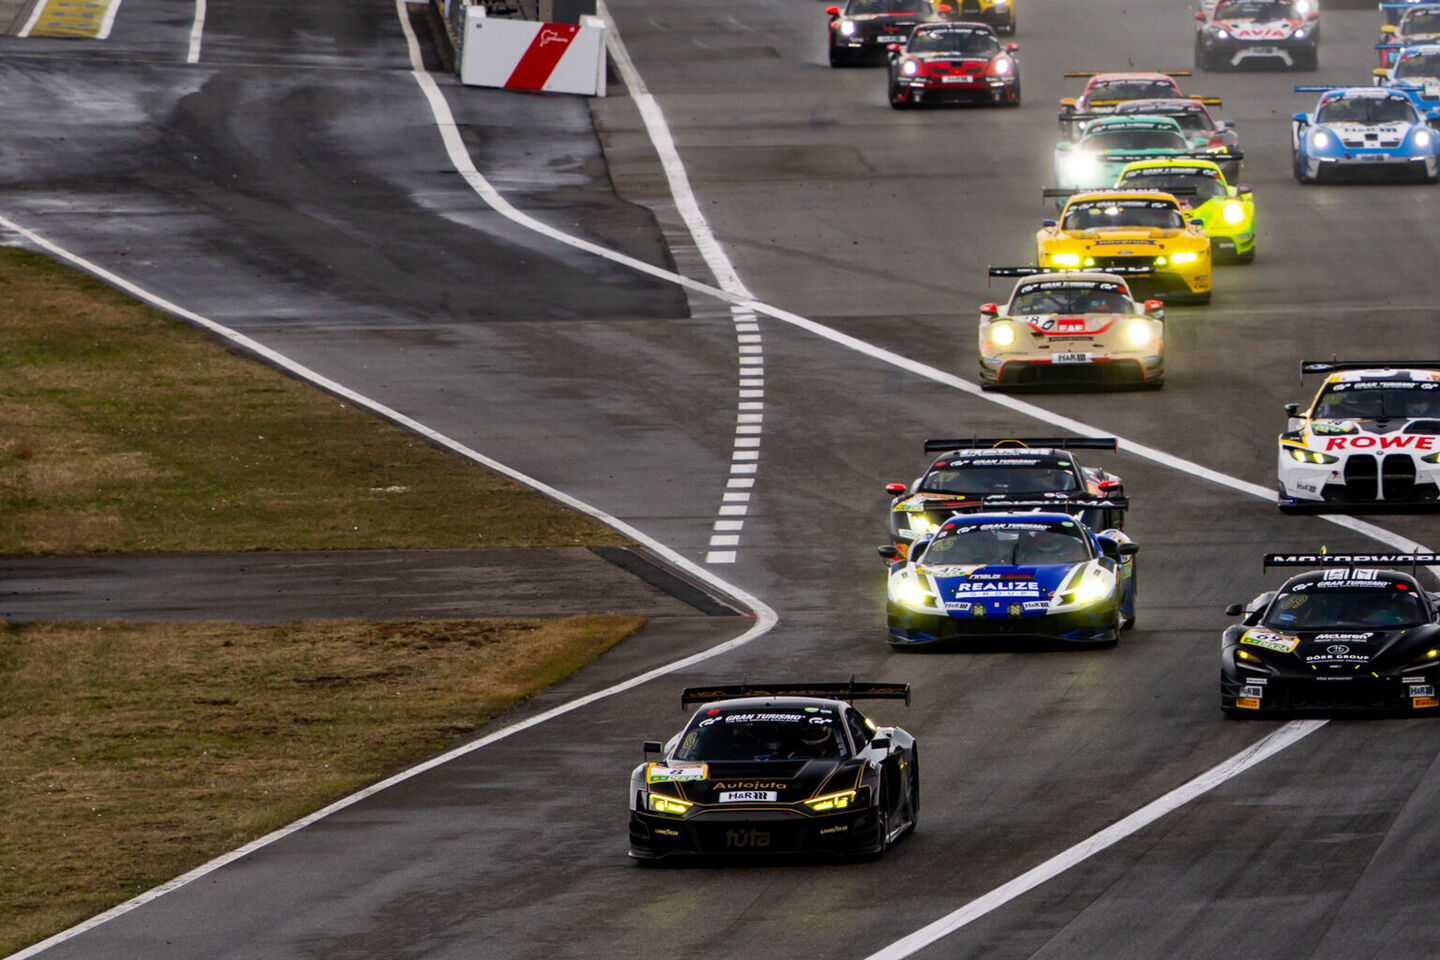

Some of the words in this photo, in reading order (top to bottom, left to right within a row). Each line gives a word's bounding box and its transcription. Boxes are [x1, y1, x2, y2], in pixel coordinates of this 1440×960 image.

[1326, 436, 1436, 451] ROWE
[958, 582, 1039, 591] REALIZE
[713, 781, 787, 790] Autojuta
[728, 792, 752, 800] H&R
